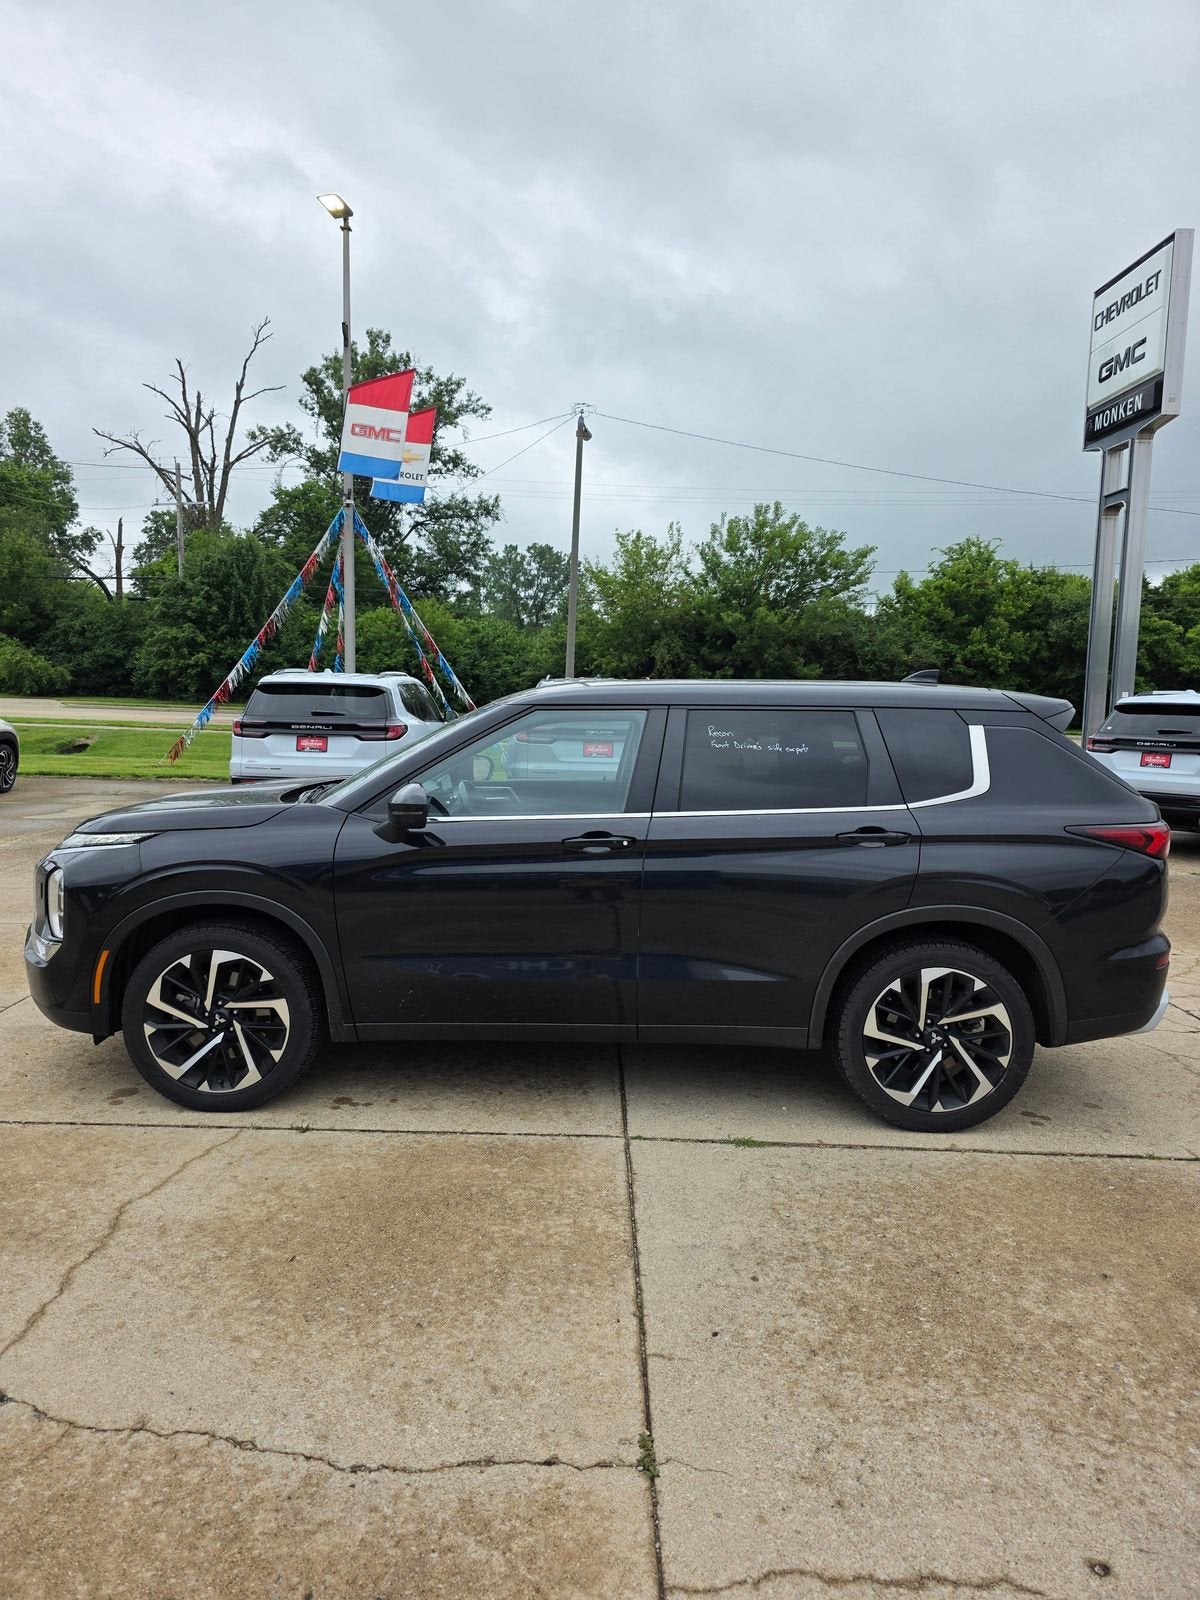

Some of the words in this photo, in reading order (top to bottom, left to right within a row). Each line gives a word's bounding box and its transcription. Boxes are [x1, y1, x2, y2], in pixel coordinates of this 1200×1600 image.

[1094, 269, 1162, 332] CHEVROLET
[1098, 337, 1147, 384] GMC
[1094, 393, 1143, 432] MONKEN
[350, 423, 402, 443] GMC
[400, 471, 424, 481] ROLET
[767, 743, 783, 752] side
